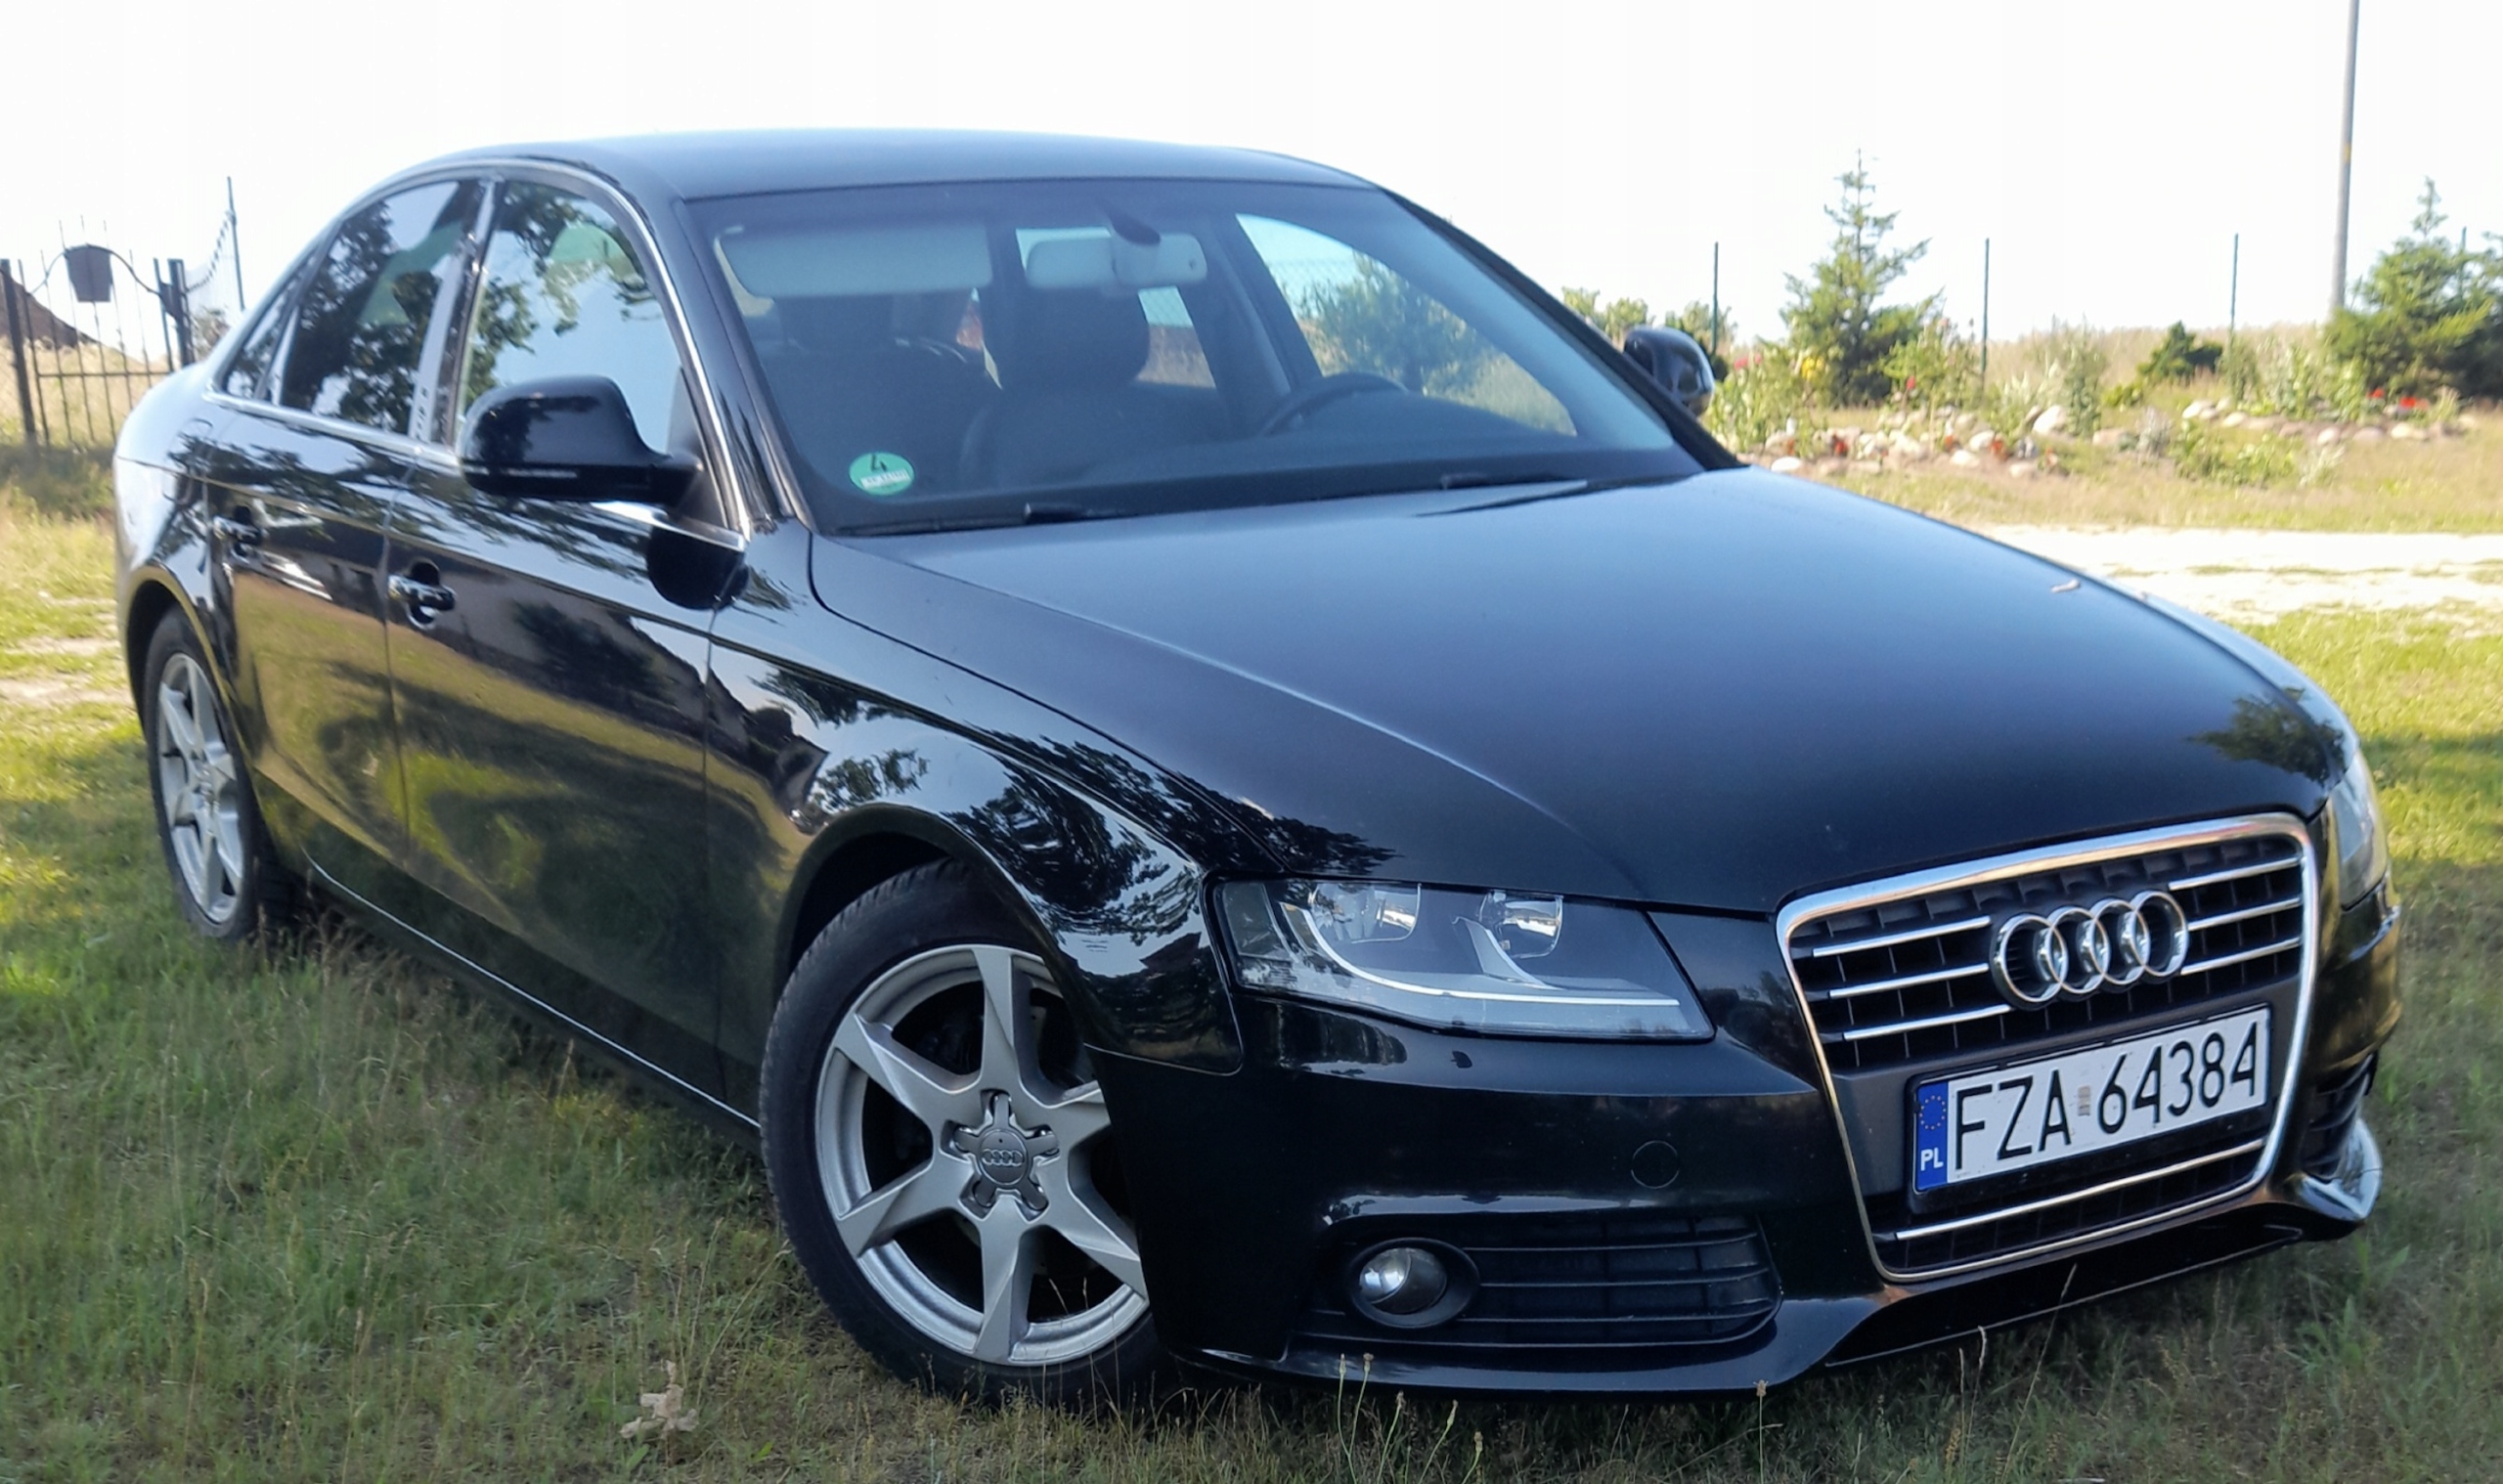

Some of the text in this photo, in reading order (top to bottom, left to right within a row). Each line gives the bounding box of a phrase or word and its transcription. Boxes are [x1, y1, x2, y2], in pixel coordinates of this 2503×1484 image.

[1955, 1021, 2258, 1170] FZA 64384
[1920, 1147, 1944, 1171] PL
